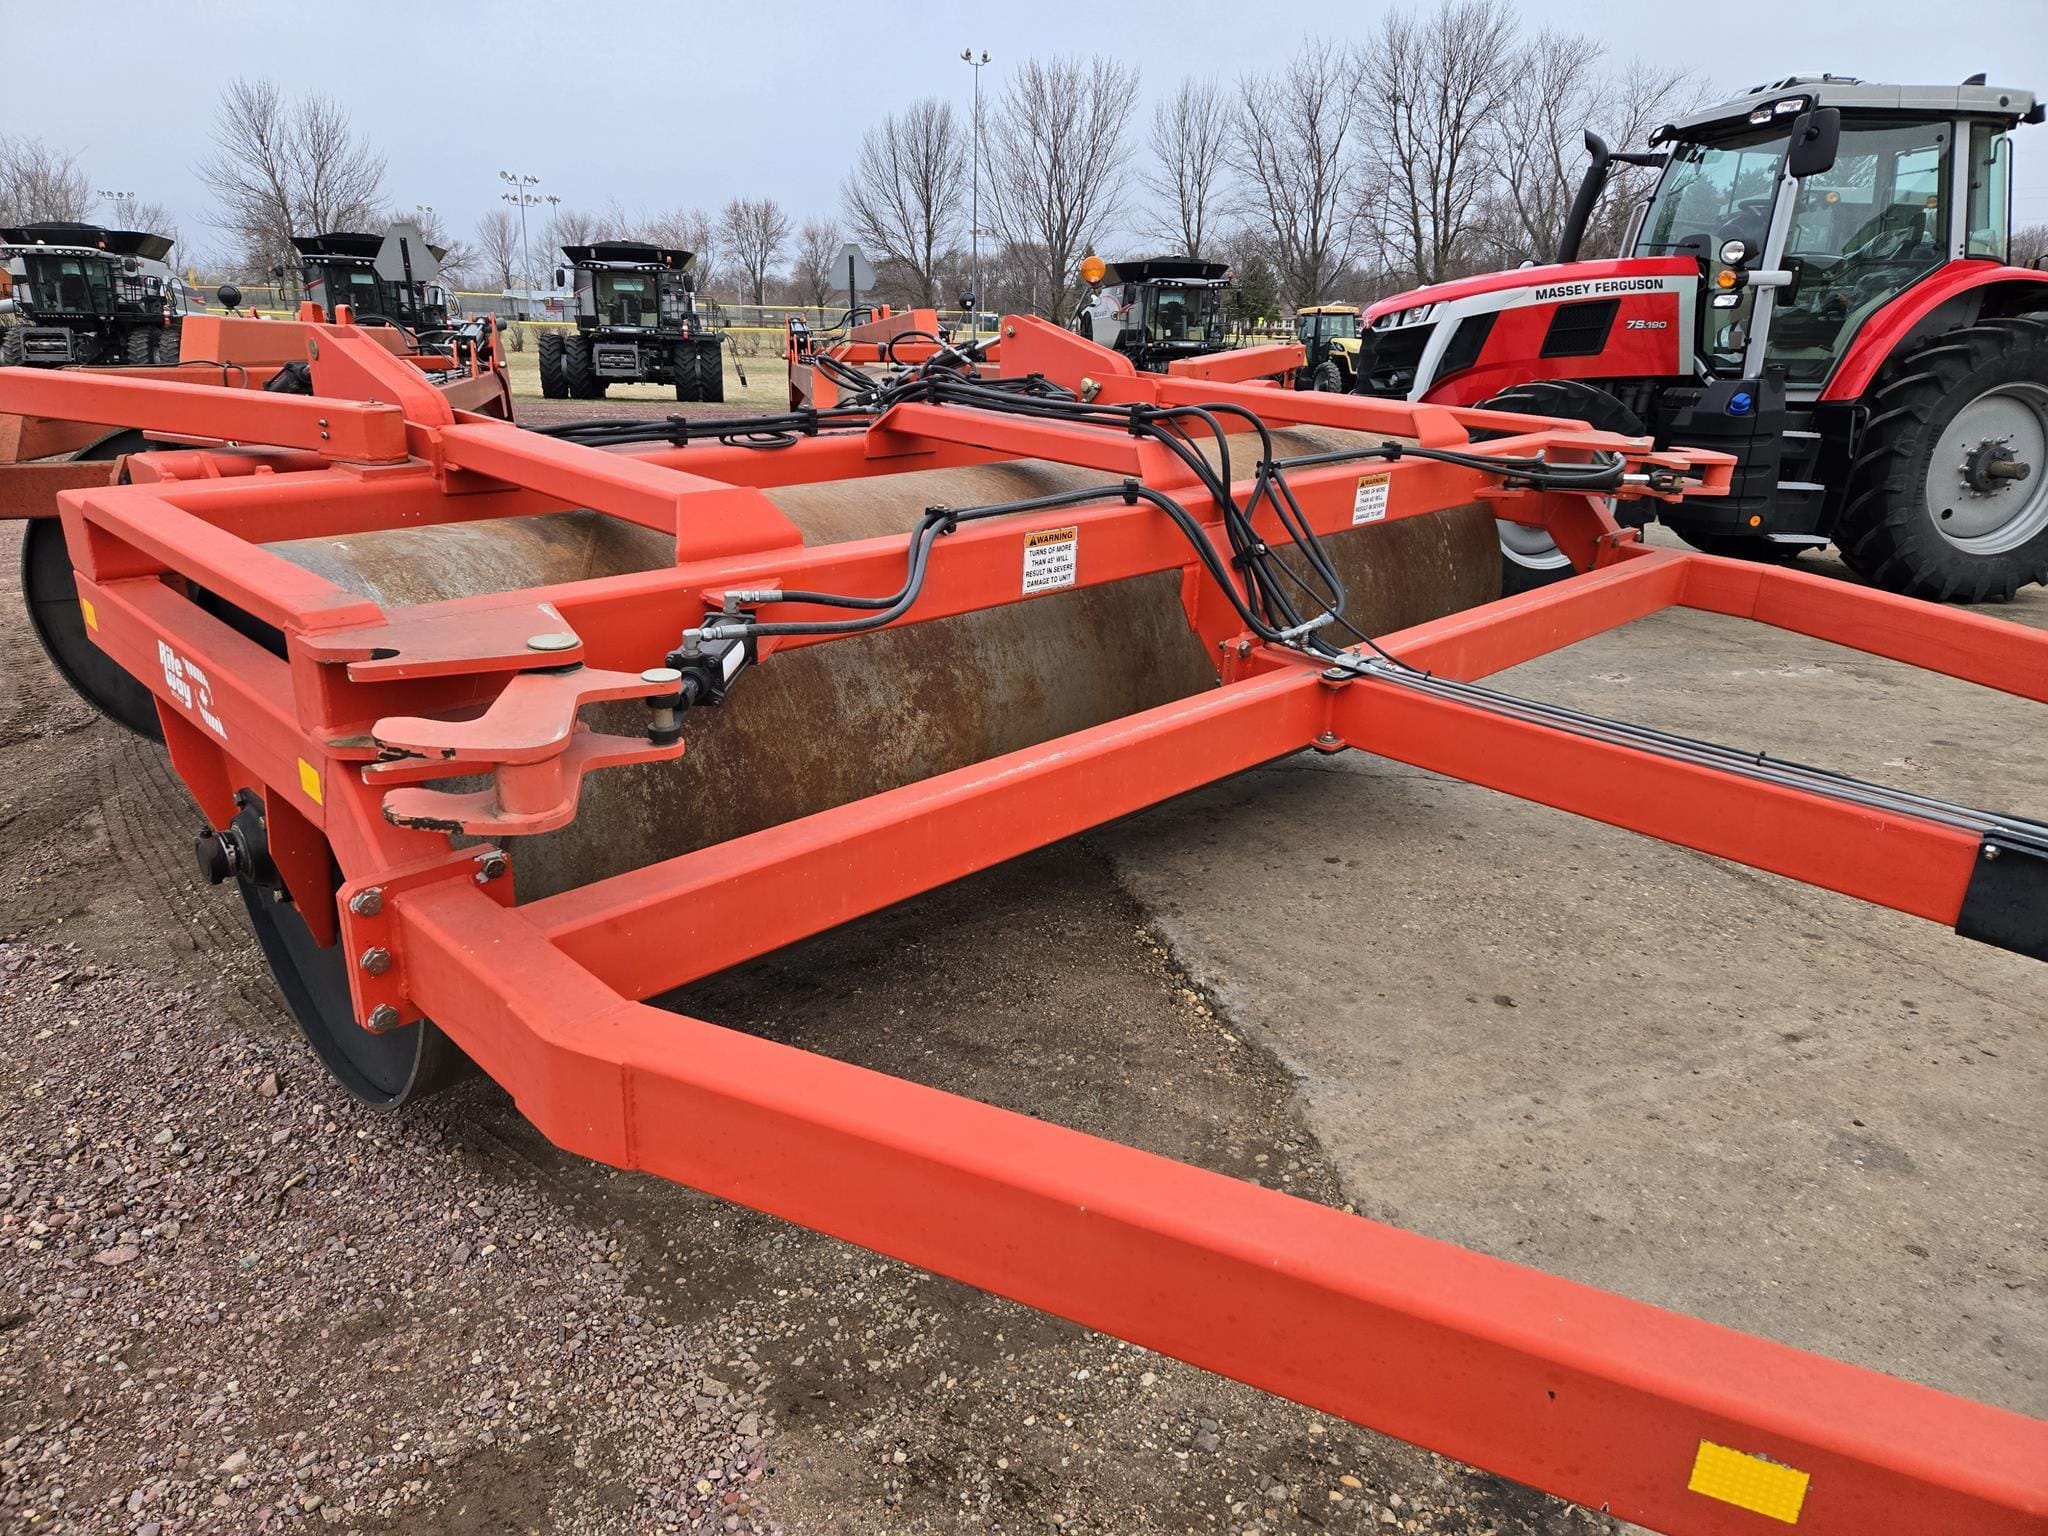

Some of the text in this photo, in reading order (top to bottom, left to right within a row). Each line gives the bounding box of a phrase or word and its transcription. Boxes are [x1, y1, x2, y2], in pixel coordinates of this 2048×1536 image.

[1535, 278, 1664, 300] MASSEY FERGUSON
[1037, 531, 1073, 544] WARNING
[1029, 548, 1047, 557] TURNS
[1056, 544, 1072, 552] MORE
[1032, 558, 1046, 567] THAN
[1026, 568, 1046, 578] RESULT
[1053, 563, 1073, 573] SEVERE
[1026, 578, 1050, 588] DAMAGE
[1059, 574, 1071, 582] UNIT
[158, 640, 183, 678] Rite
